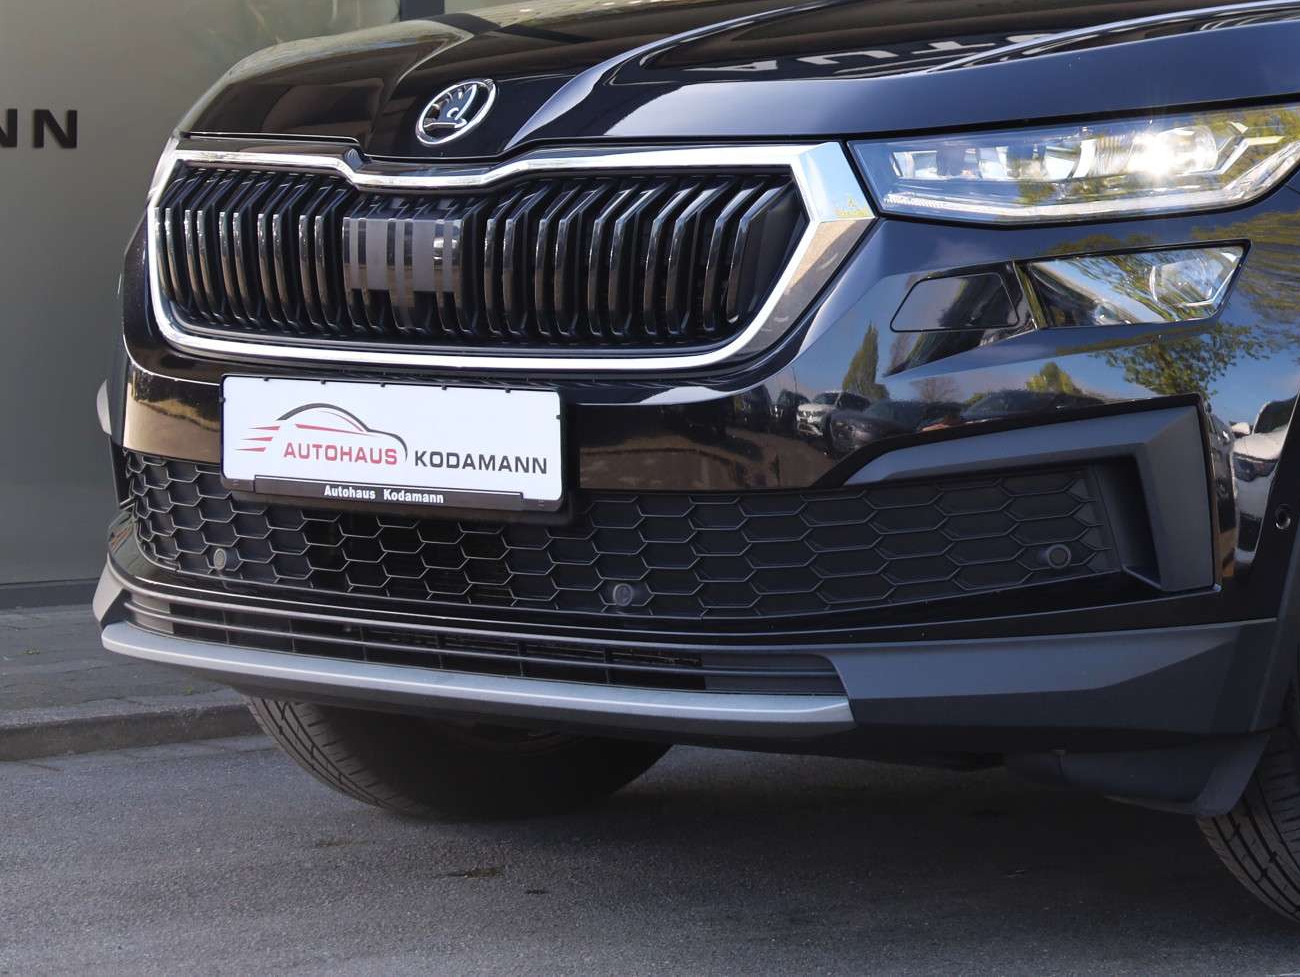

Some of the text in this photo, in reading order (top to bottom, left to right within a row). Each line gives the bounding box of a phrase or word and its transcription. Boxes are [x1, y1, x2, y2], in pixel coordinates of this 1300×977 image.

[283, 442, 548, 475] AUTOHAUS KODAMANN
[324, 485, 444, 504] Autohaus Kodamann
